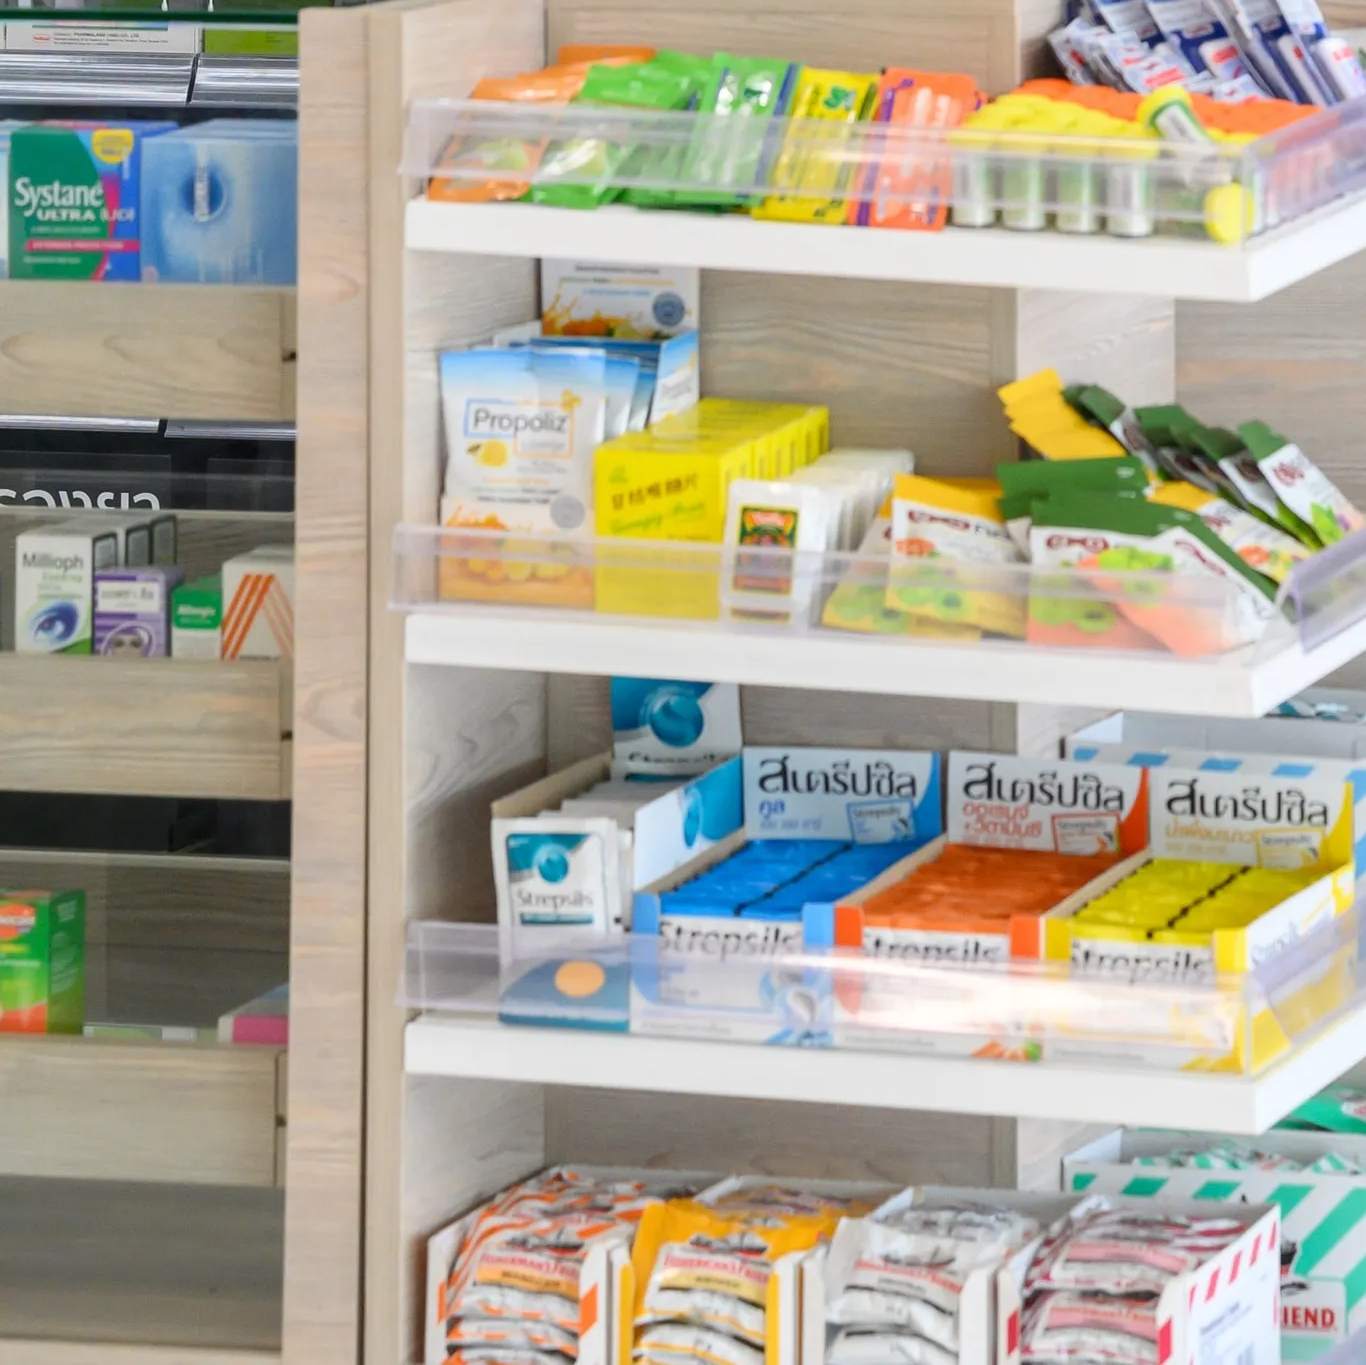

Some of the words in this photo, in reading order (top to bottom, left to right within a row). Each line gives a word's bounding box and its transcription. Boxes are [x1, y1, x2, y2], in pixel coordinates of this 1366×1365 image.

[14, 176, 104, 218] Systane
[515, 887, 594, 916] Strepsils
[1280, 1307, 1337, 1331] IEND
